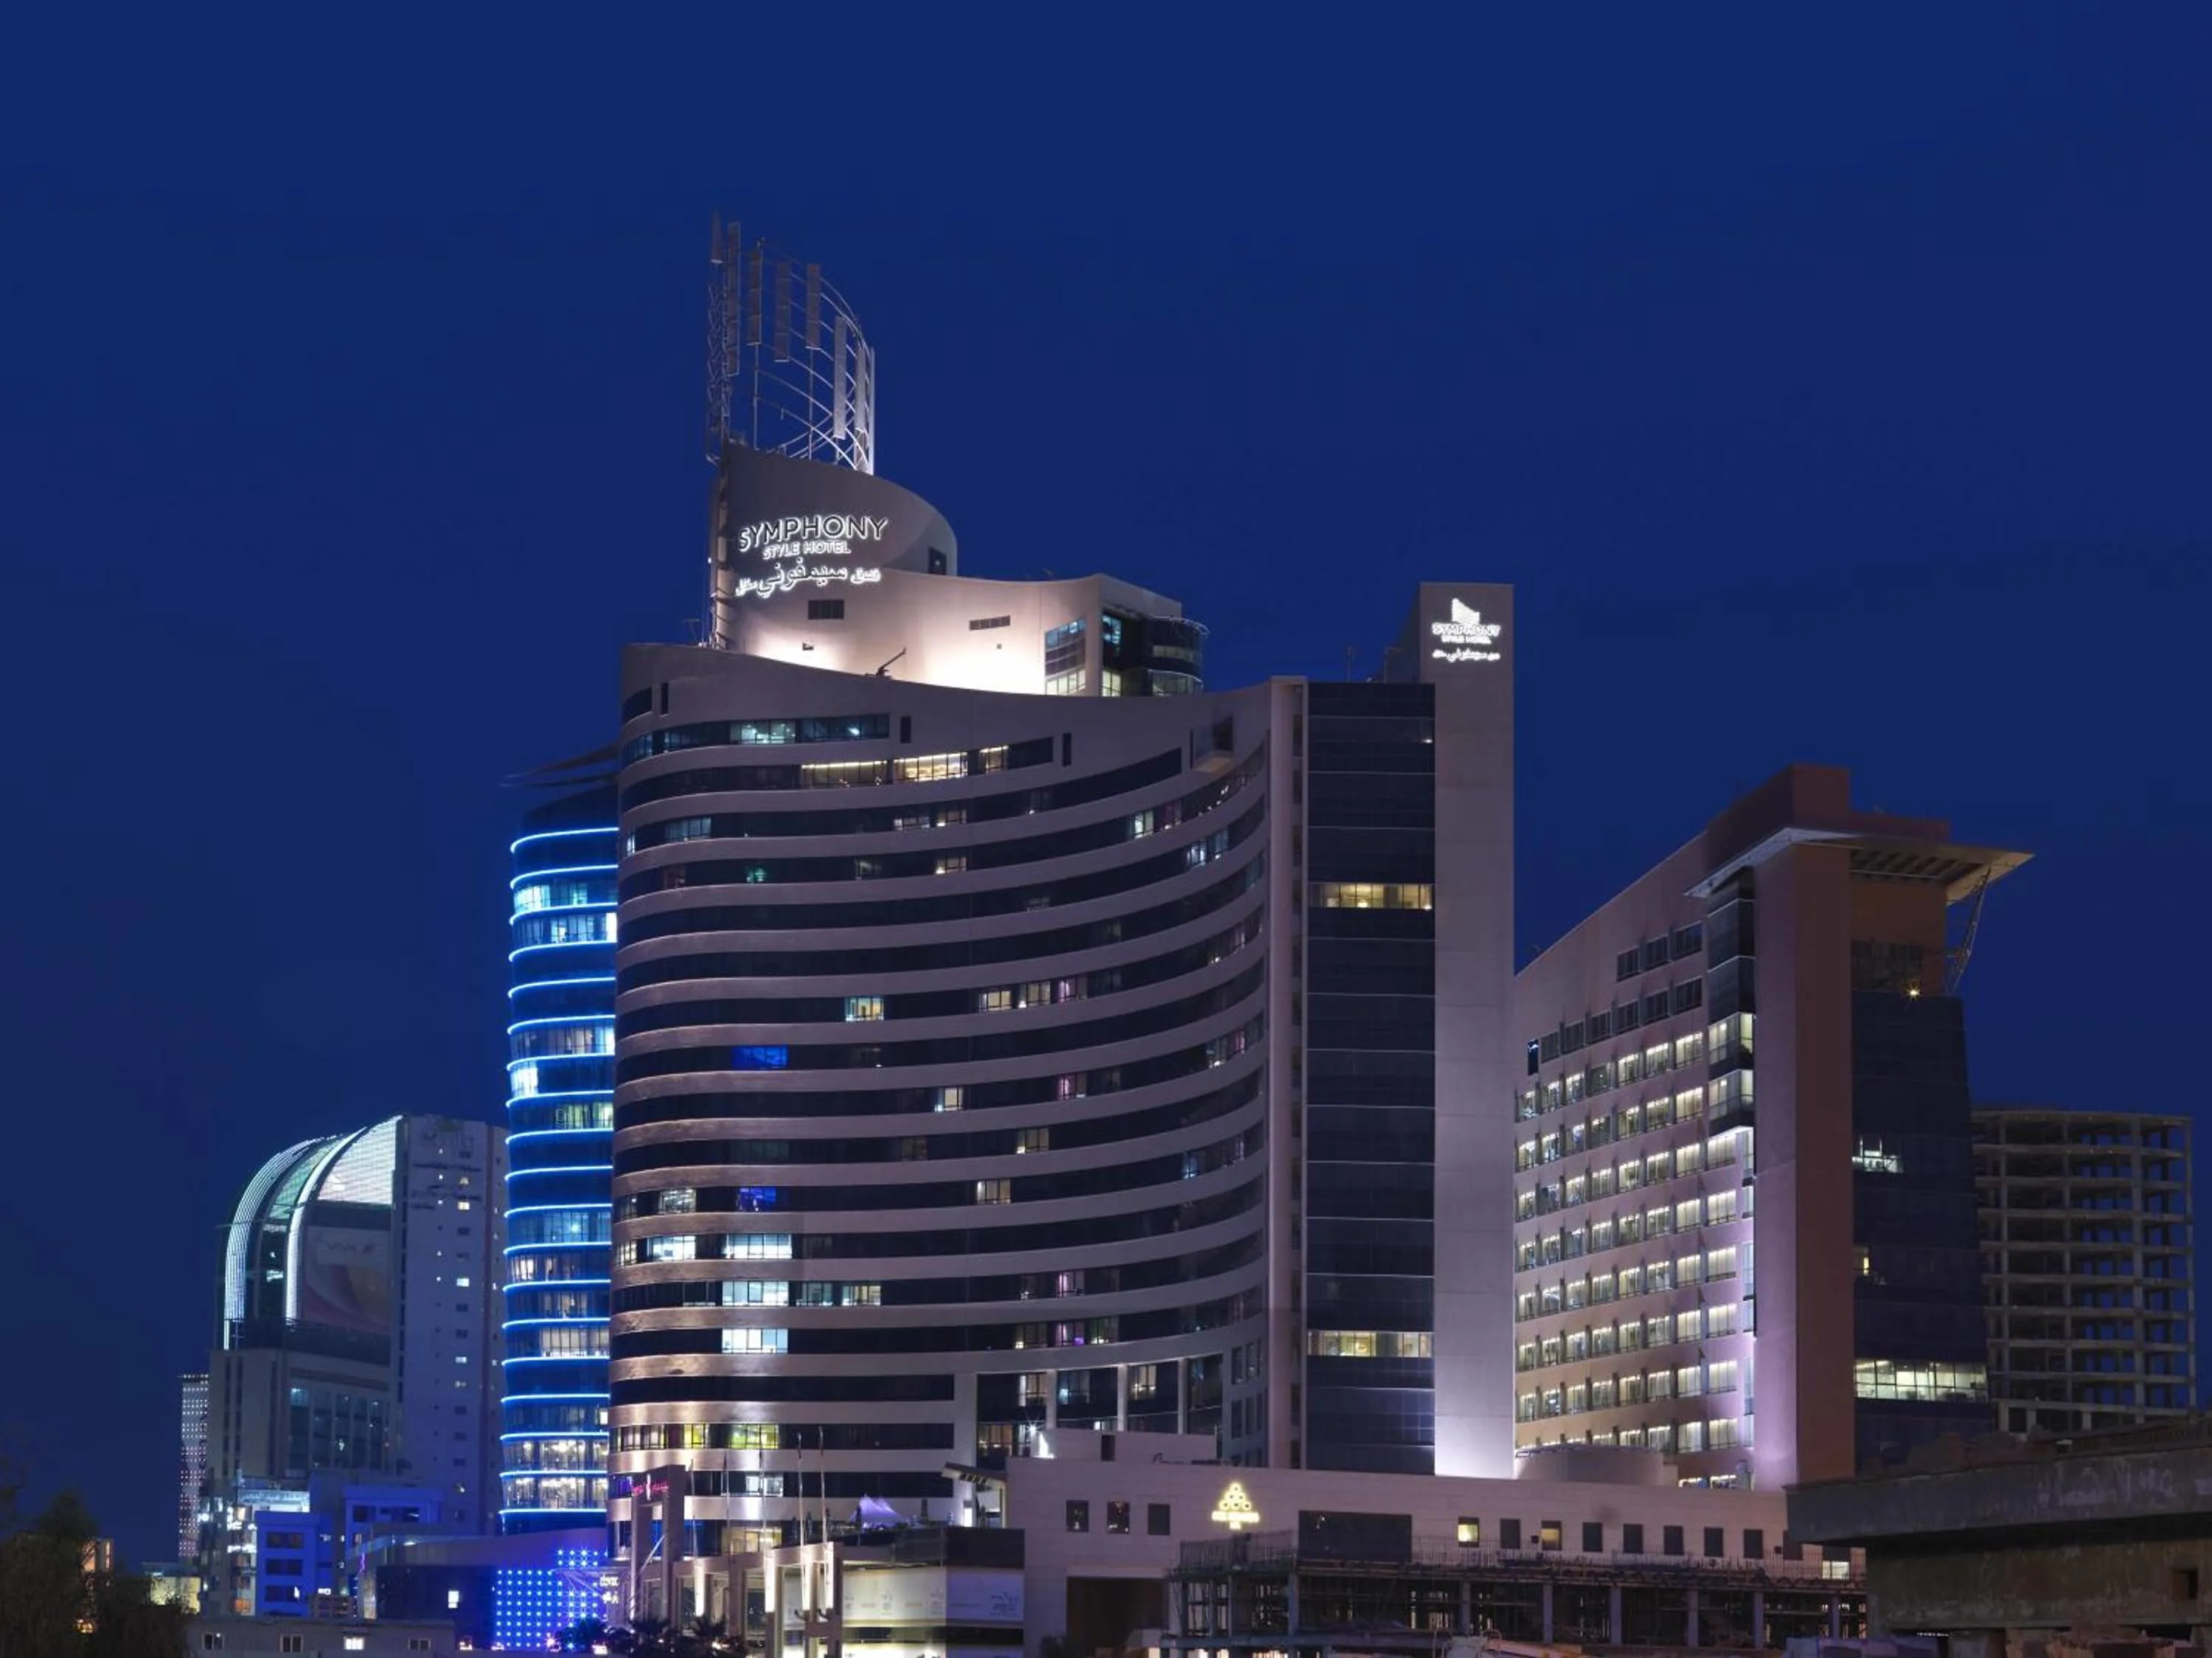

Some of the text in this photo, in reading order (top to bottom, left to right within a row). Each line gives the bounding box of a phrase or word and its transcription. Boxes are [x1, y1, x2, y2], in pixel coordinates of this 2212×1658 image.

[740, 515, 888, 552] SYMPHONY
[762, 539, 852, 560] STYLE HOTEL
[757, 556, 847, 598] سيمفوني
